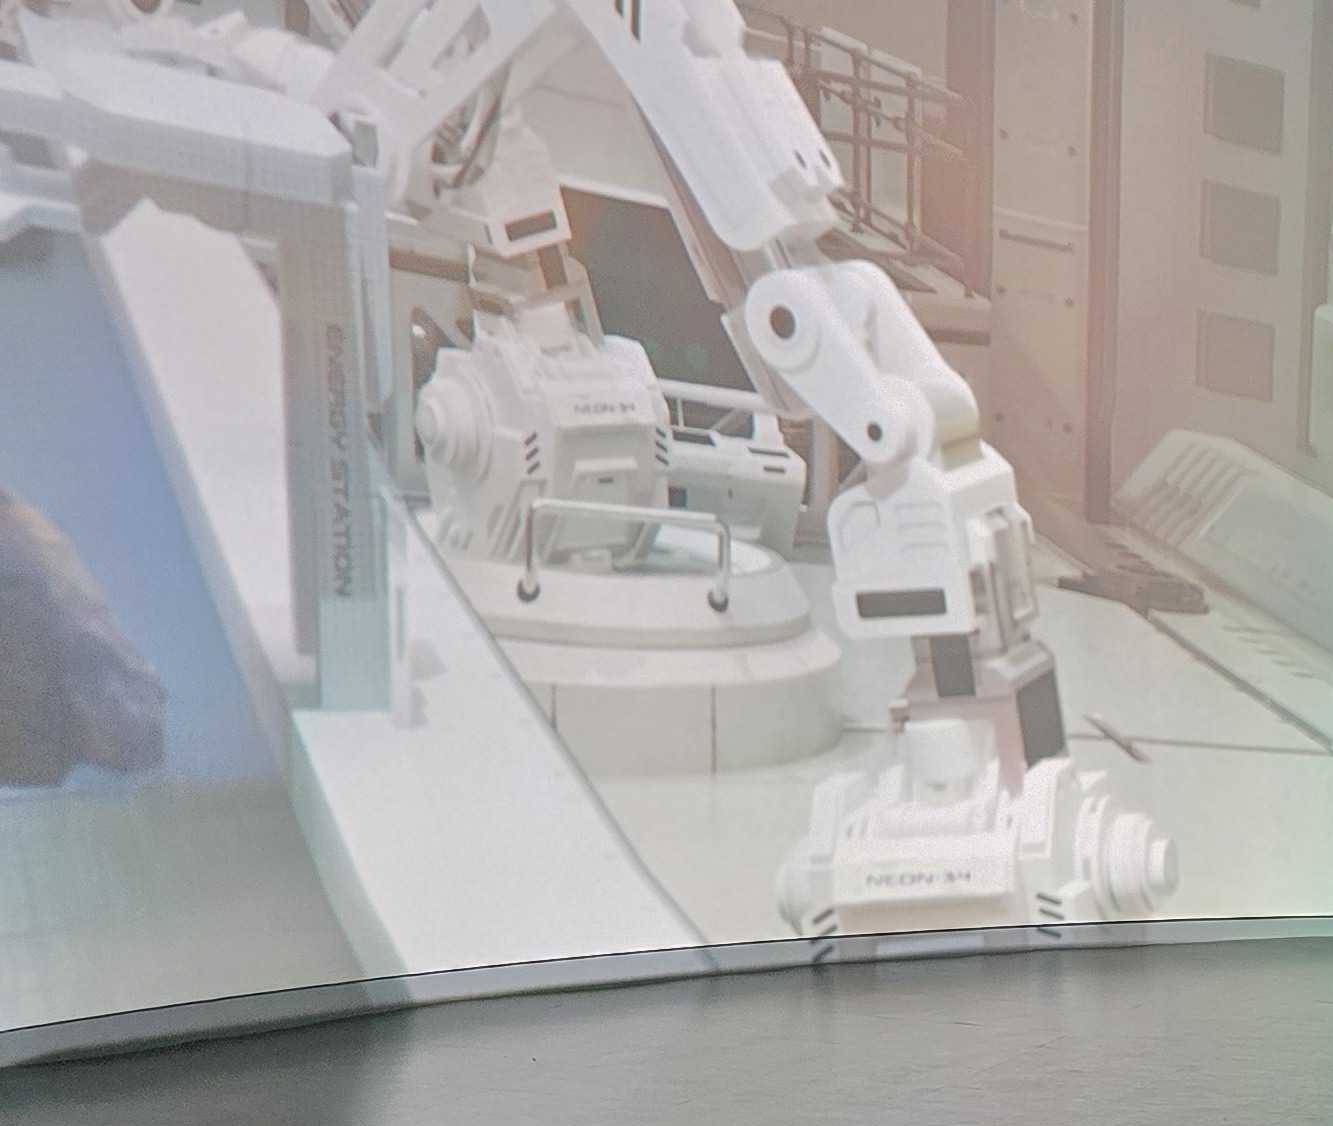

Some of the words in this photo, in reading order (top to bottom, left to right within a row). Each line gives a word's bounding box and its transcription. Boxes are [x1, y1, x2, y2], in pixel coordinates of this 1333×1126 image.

[325, 324, 346, 450] ENERGY
[329, 459, 351, 597] STATION
[866, 871, 934, 888] NEON
